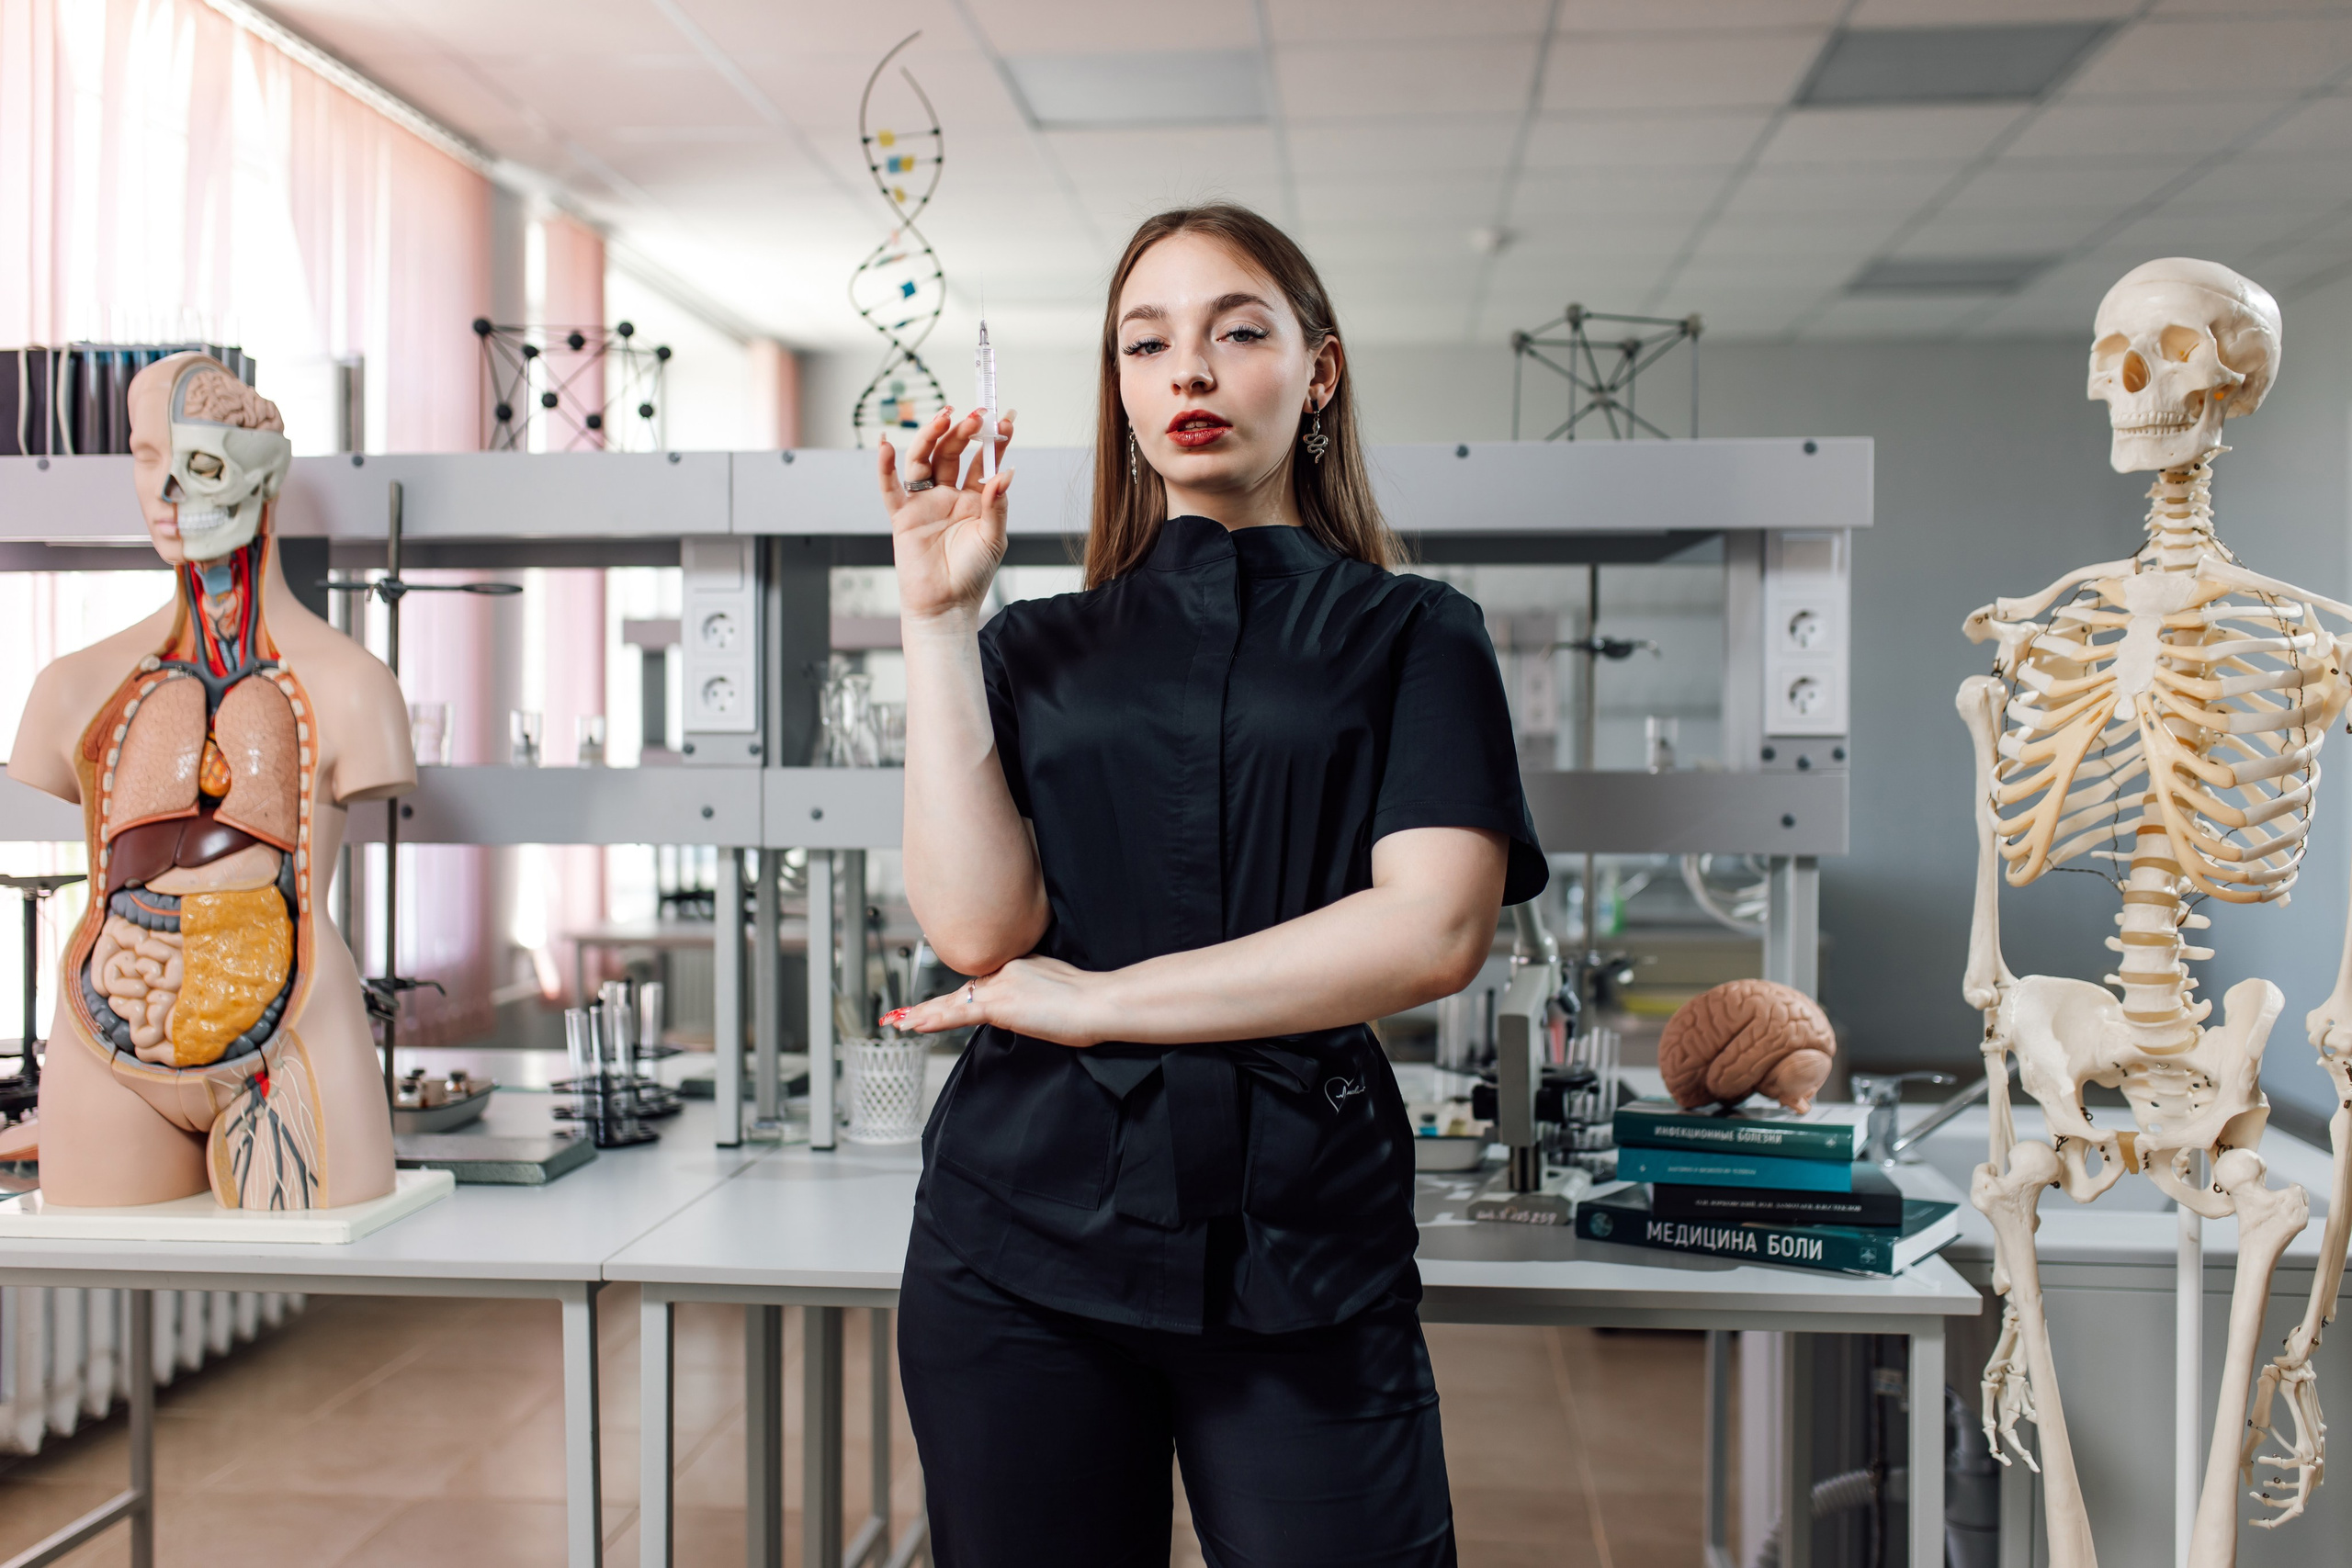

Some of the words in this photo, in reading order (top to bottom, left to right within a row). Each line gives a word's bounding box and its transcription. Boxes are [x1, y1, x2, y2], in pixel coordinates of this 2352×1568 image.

[1655, 1125, 1735, 1142] ИНФЕКЦИОННЫЕ
[1736, 1130, 1782, 1145] БОЛЕЗНИ
[1646, 1220, 1758, 1253] МЕДИЦИНА
[1768, 1235, 1823, 1260] БОЛИ
